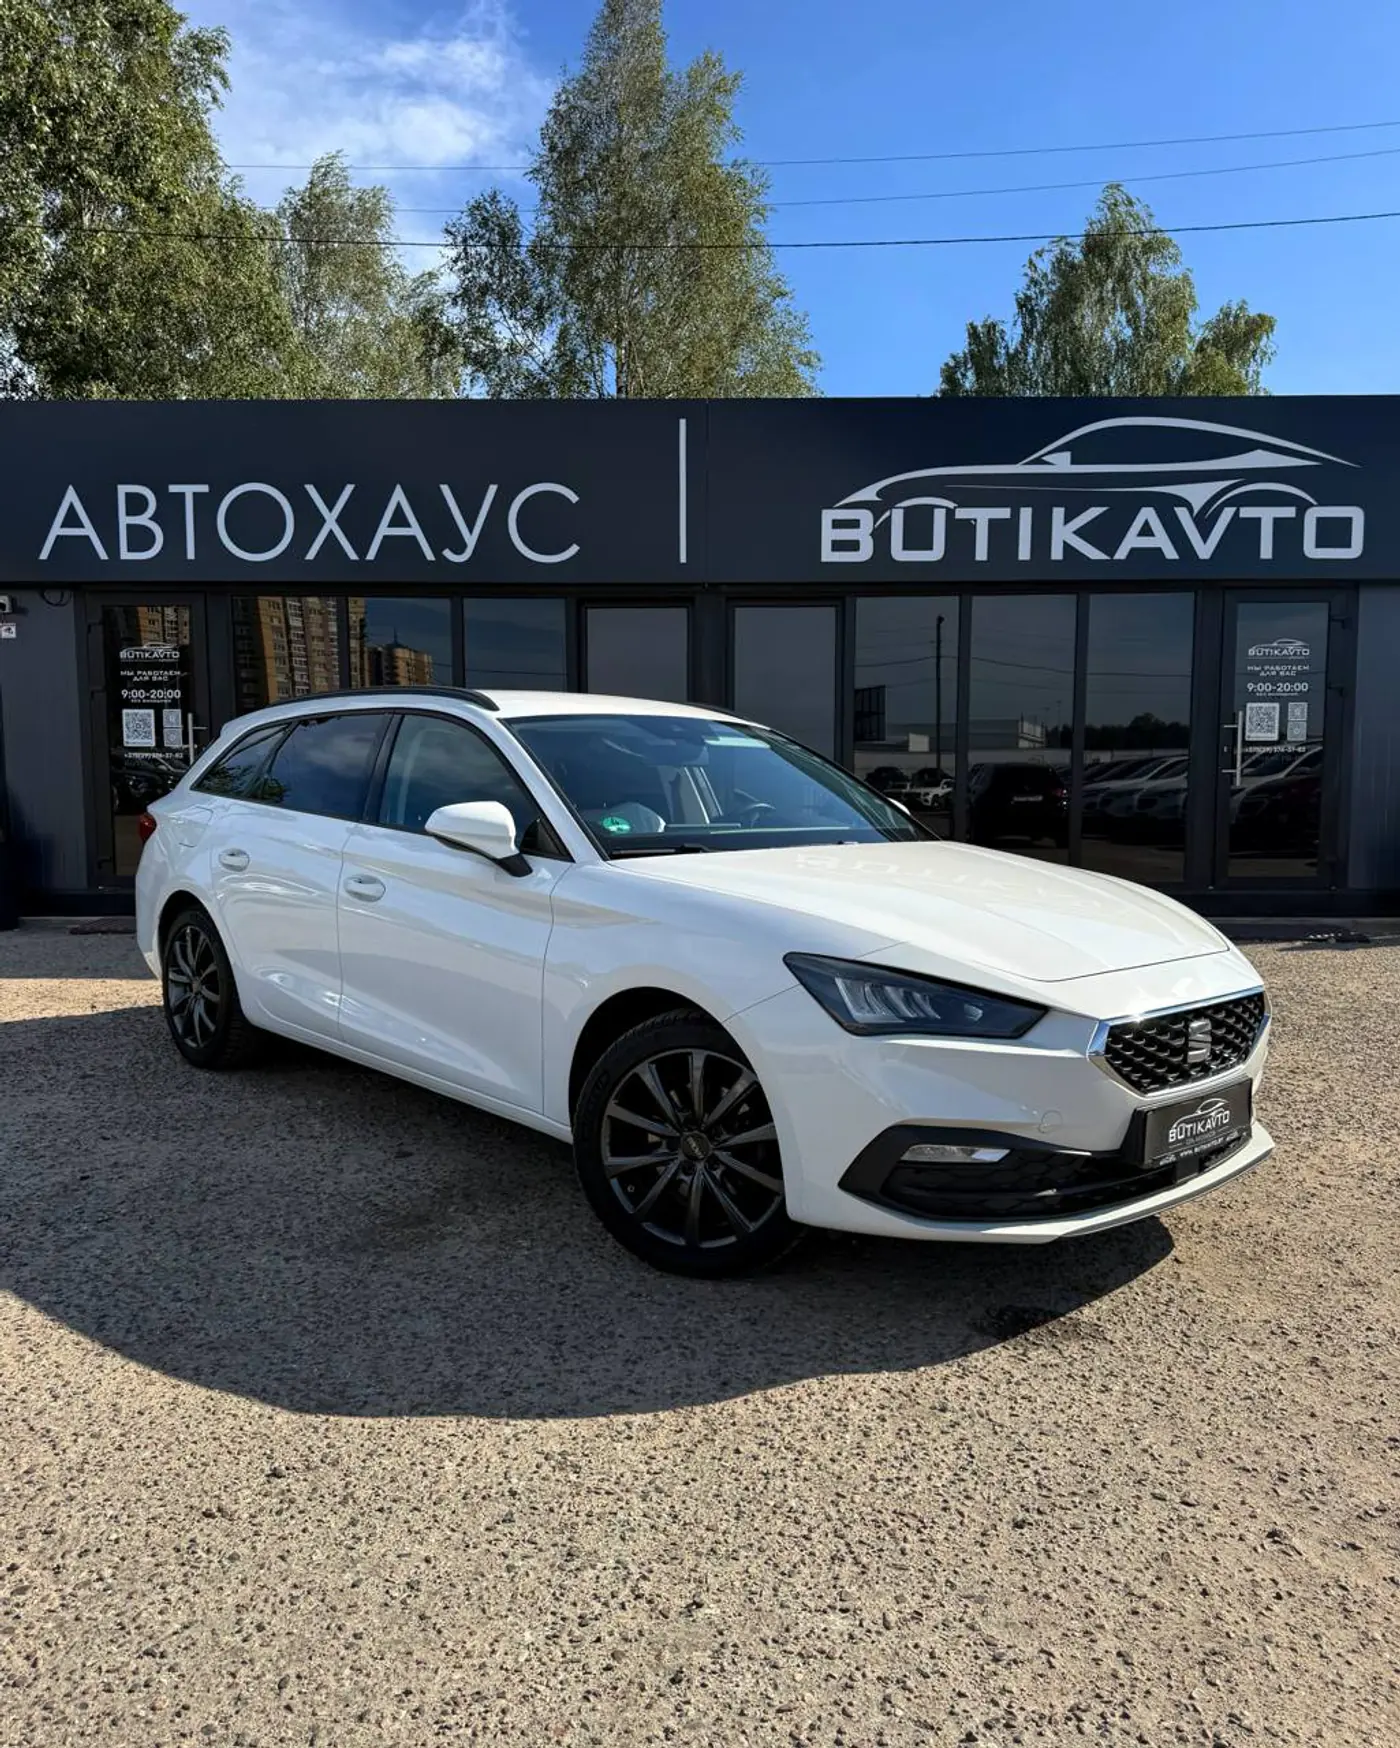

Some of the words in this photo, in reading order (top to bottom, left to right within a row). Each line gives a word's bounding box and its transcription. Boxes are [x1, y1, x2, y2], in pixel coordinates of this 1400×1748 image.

[39, 482, 580, 563] АВТОХАУС
[820, 505, 1365, 563] BUTIKAVTO
[119, 651, 181, 659] BUTIKAVTO
[1247, 648, 1310, 656] BUTIKAVTO
[1247, 682, 1309, 692] 9:00-20:00
[121, 689, 182, 699] 9:00-20:00
[1168, 1109, 1231, 1143] BUTIKAVTO
